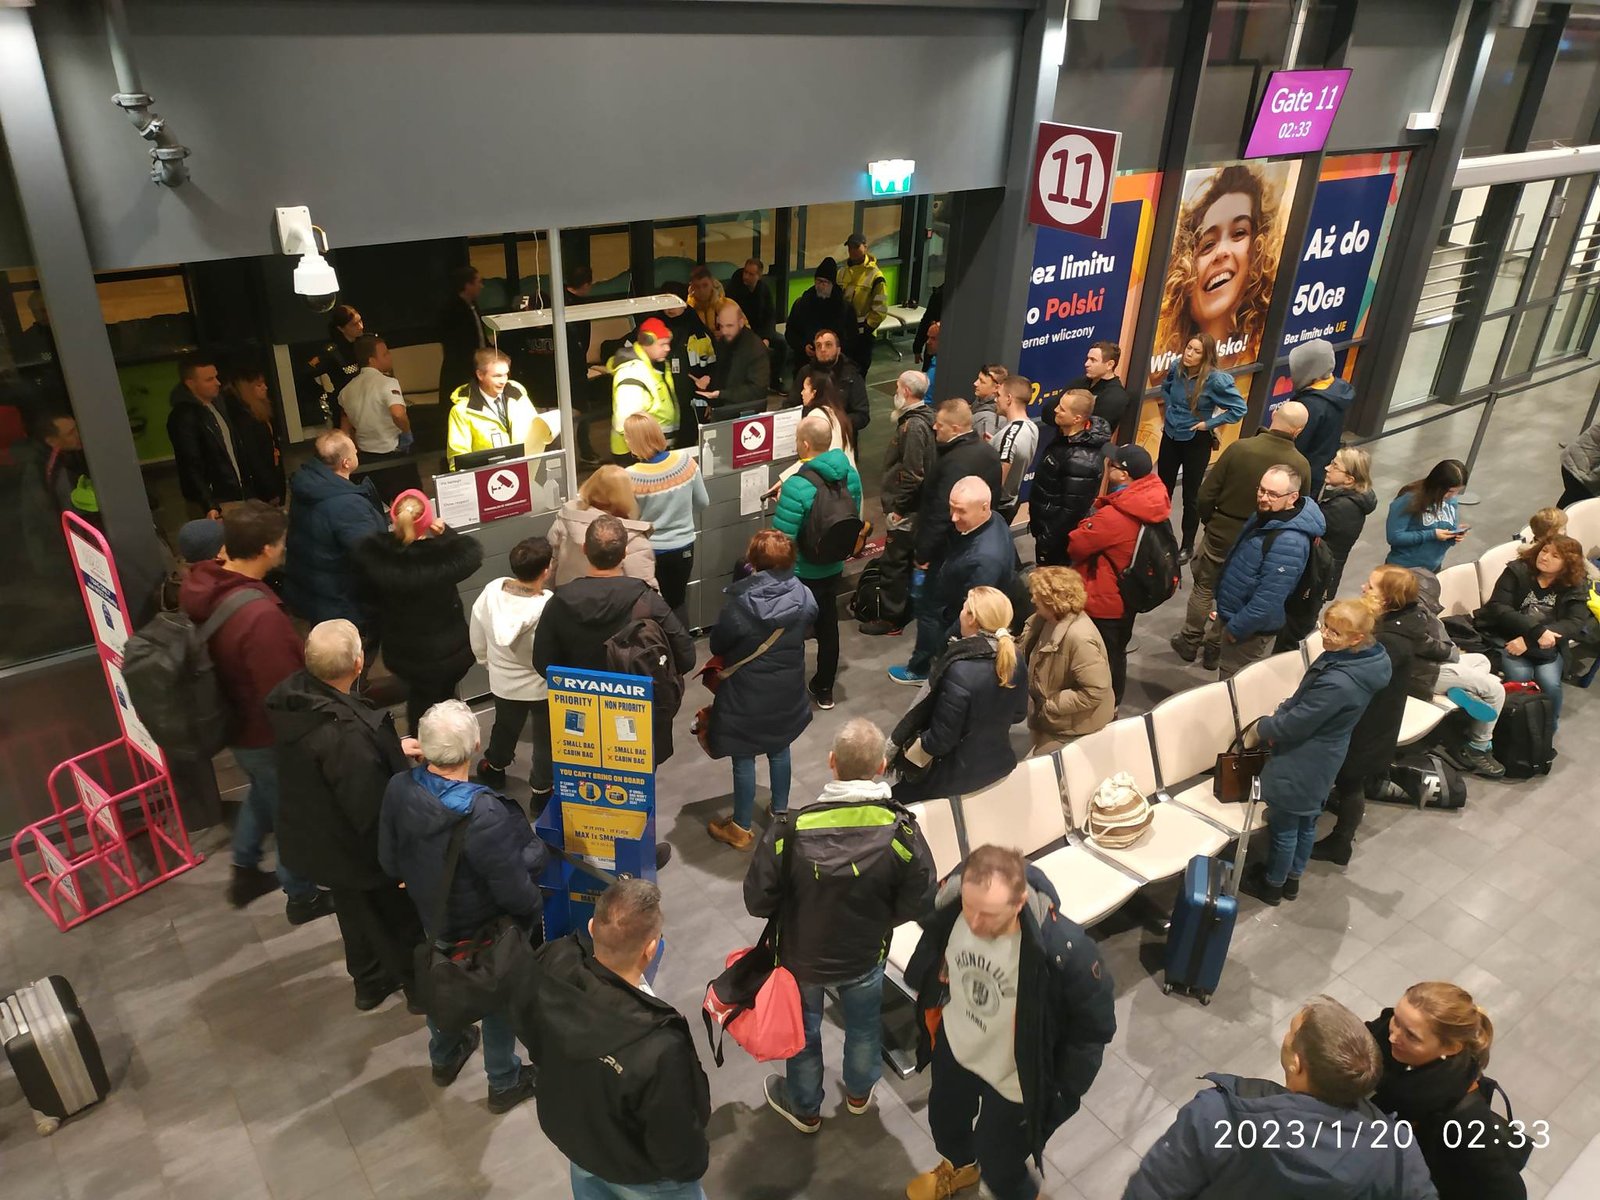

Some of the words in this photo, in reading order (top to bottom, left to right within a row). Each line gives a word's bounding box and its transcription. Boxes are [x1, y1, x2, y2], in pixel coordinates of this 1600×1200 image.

[1272, 86, 1312, 114] Gate
[1316, 86, 1338, 110] 11
[1278, 121, 1312, 140] 02:33
[1048, 149, 1093, 210] 11
[1303, 224, 1337, 262] Aż
[1340, 220, 1370, 255] do
[1030, 265, 1056, 285] ez
[1060, 250, 1115, 280] limitu
[1024, 307, 1040, 325] o
[1045, 288, 1105, 321] Polski
[1292, 281, 1346, 316] 50GB
[1022, 333, 1049, 349] ernet
[1052, 326, 1095, 343] wliczony
[1284, 334, 1300, 345] Bez
[1300, 326, 1322, 342] limitu
[1324, 324, 1334, 336] do
[1335, 320, 1348, 333] UE
[1216, 334, 1248, 357] lsko!
[1024, 472, 1036, 482] eu
[564, 678, 646, 697] RYANAIR
[554, 694, 592, 707] PRIORITY
[604, 700, 617, 710] NON
[618, 702, 646, 712] PRIORITY
[563, 740, 582, 748] SMALL
[614, 746, 634, 754] SMALL
[560, 768, 572, 776] YOU
[592, 772, 612, 781] BRING
[624, 776, 645, 785] BOARD
[575, 830, 589, 839] MAX
